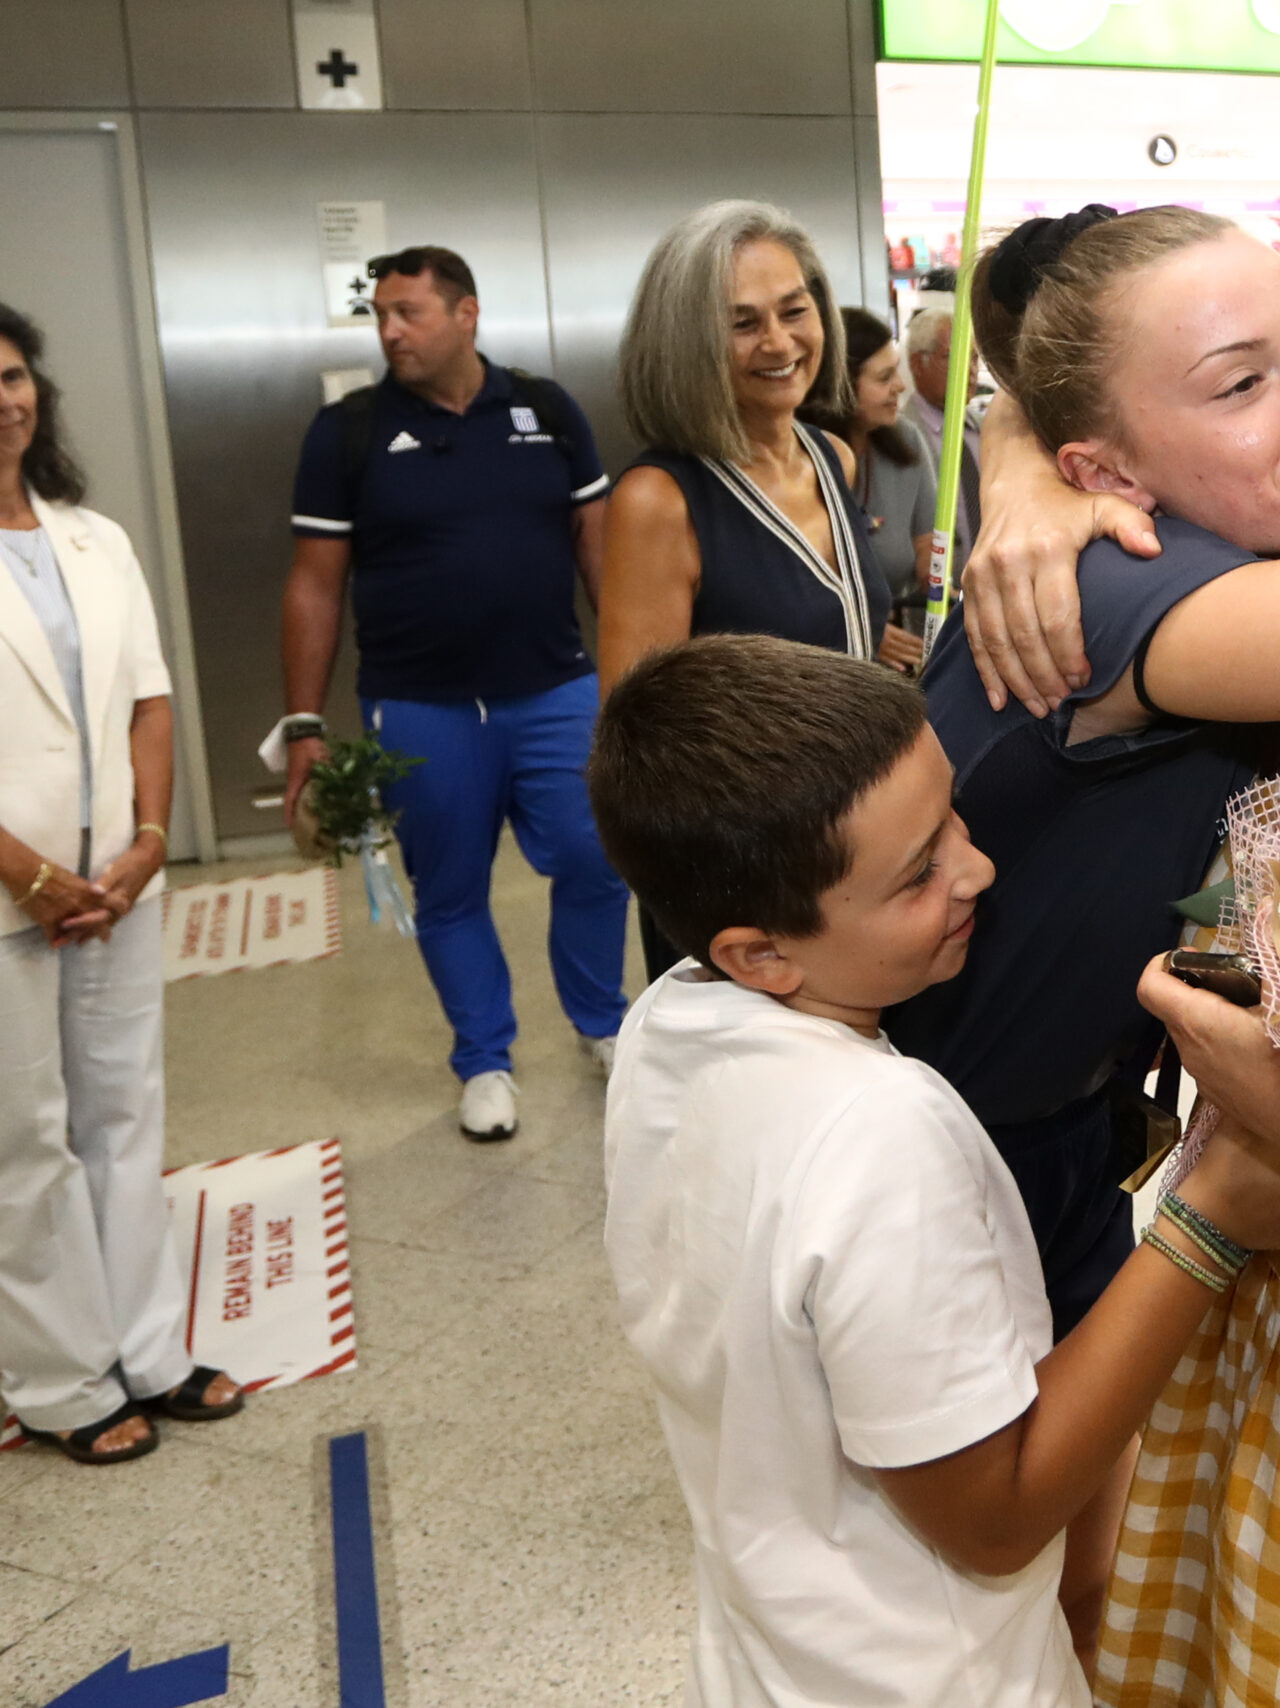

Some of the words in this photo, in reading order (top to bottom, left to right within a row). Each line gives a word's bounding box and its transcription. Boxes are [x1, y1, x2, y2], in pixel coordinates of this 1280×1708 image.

[225, 1203, 255, 1257] BEHIND
[265, 1215, 294, 1251] LINE
[222, 1258, 252, 1322] REMAIN
[265, 1251, 294, 1290] THIS
